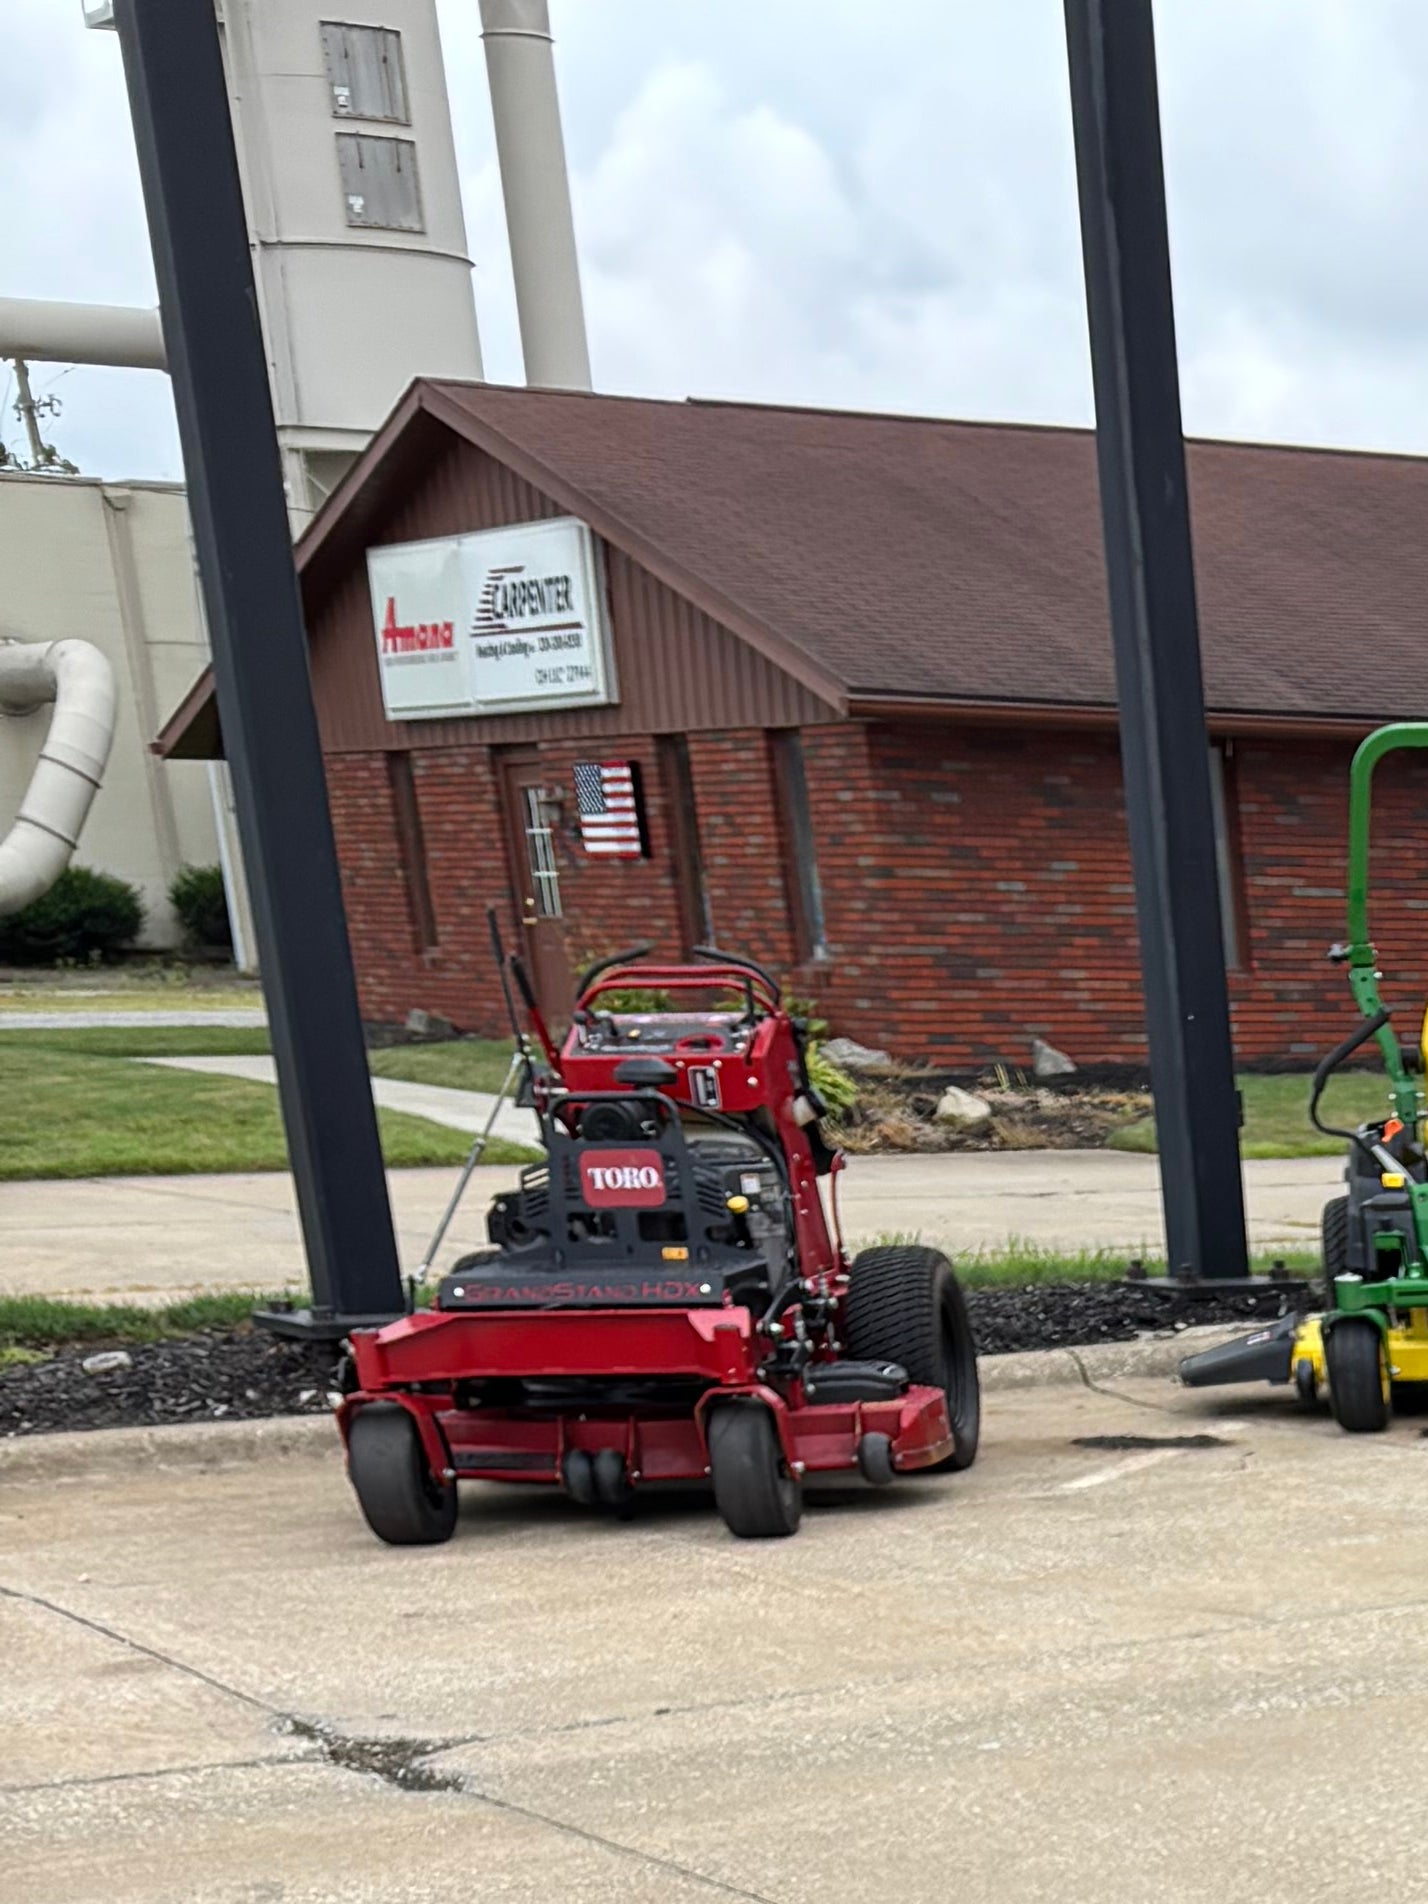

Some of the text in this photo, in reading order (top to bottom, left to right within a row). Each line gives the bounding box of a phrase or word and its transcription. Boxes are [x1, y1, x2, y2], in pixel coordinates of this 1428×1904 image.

[492, 574, 575, 619] CARPENTER
[382, 596, 454, 654] Amana
[587, 1166, 659, 1191] TORO
[640, 1280, 702, 1300] HDX
